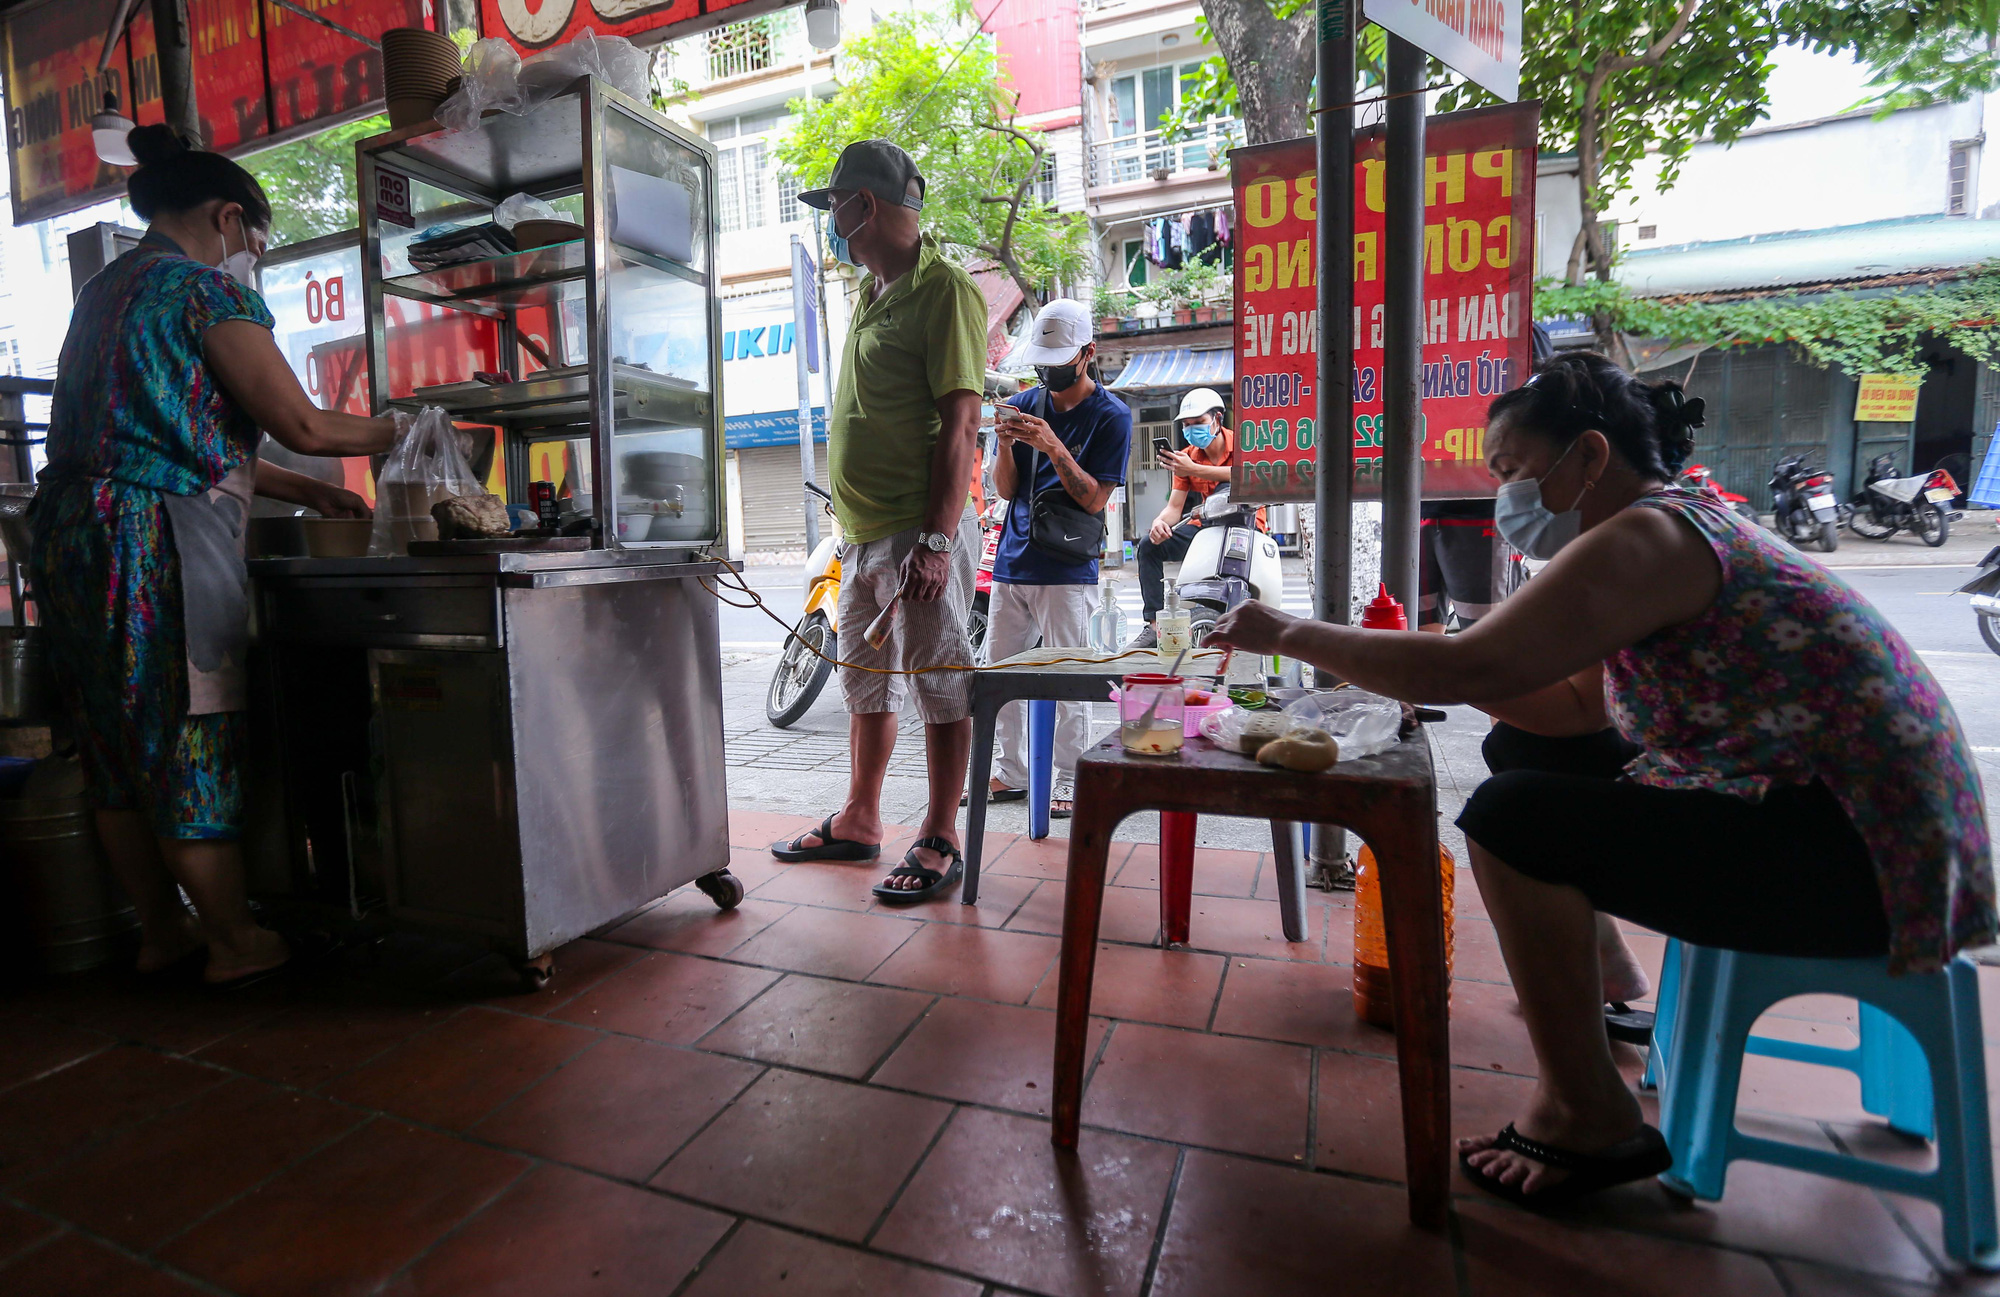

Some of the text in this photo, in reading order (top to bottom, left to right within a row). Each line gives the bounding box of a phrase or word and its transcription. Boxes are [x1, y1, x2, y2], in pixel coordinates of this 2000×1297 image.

[754, 418, 776, 428] AN
[774, 413, 825, 426] TRCH
[1108, 503, 1116, 513] M
